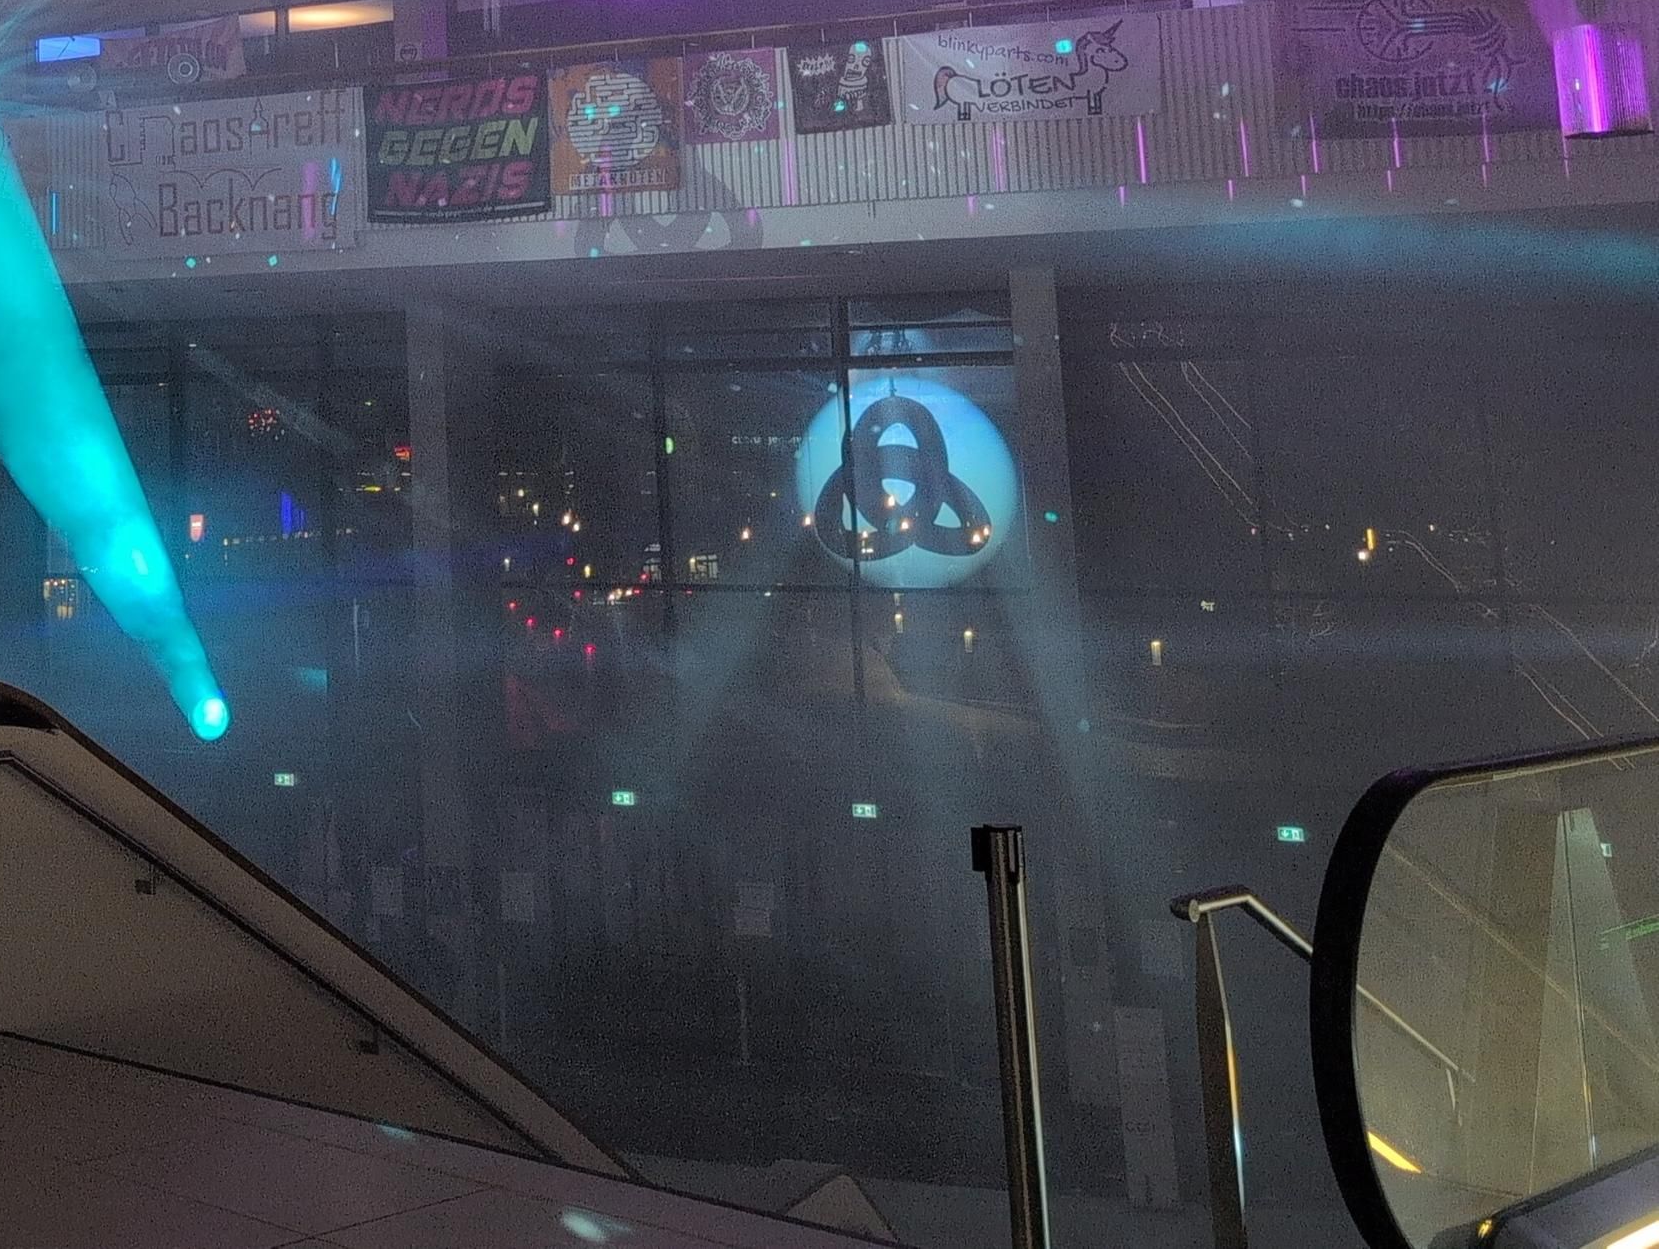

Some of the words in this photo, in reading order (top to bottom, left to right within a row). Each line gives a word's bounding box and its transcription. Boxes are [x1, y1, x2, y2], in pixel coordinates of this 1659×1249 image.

[937, 34, 1069, 68] blinkyparts.com
[374, 75, 539, 127] NERDS
[971, 95, 1080, 114] VERBINDET
[978, 72, 1075, 99] LÖTEN
[1335, 73, 1477, 102] chaos.jetzt
[378, 117, 539, 167] GEGEN
[386, 161, 534, 208] NAZIS
[158, 178, 338, 241] Backnang
